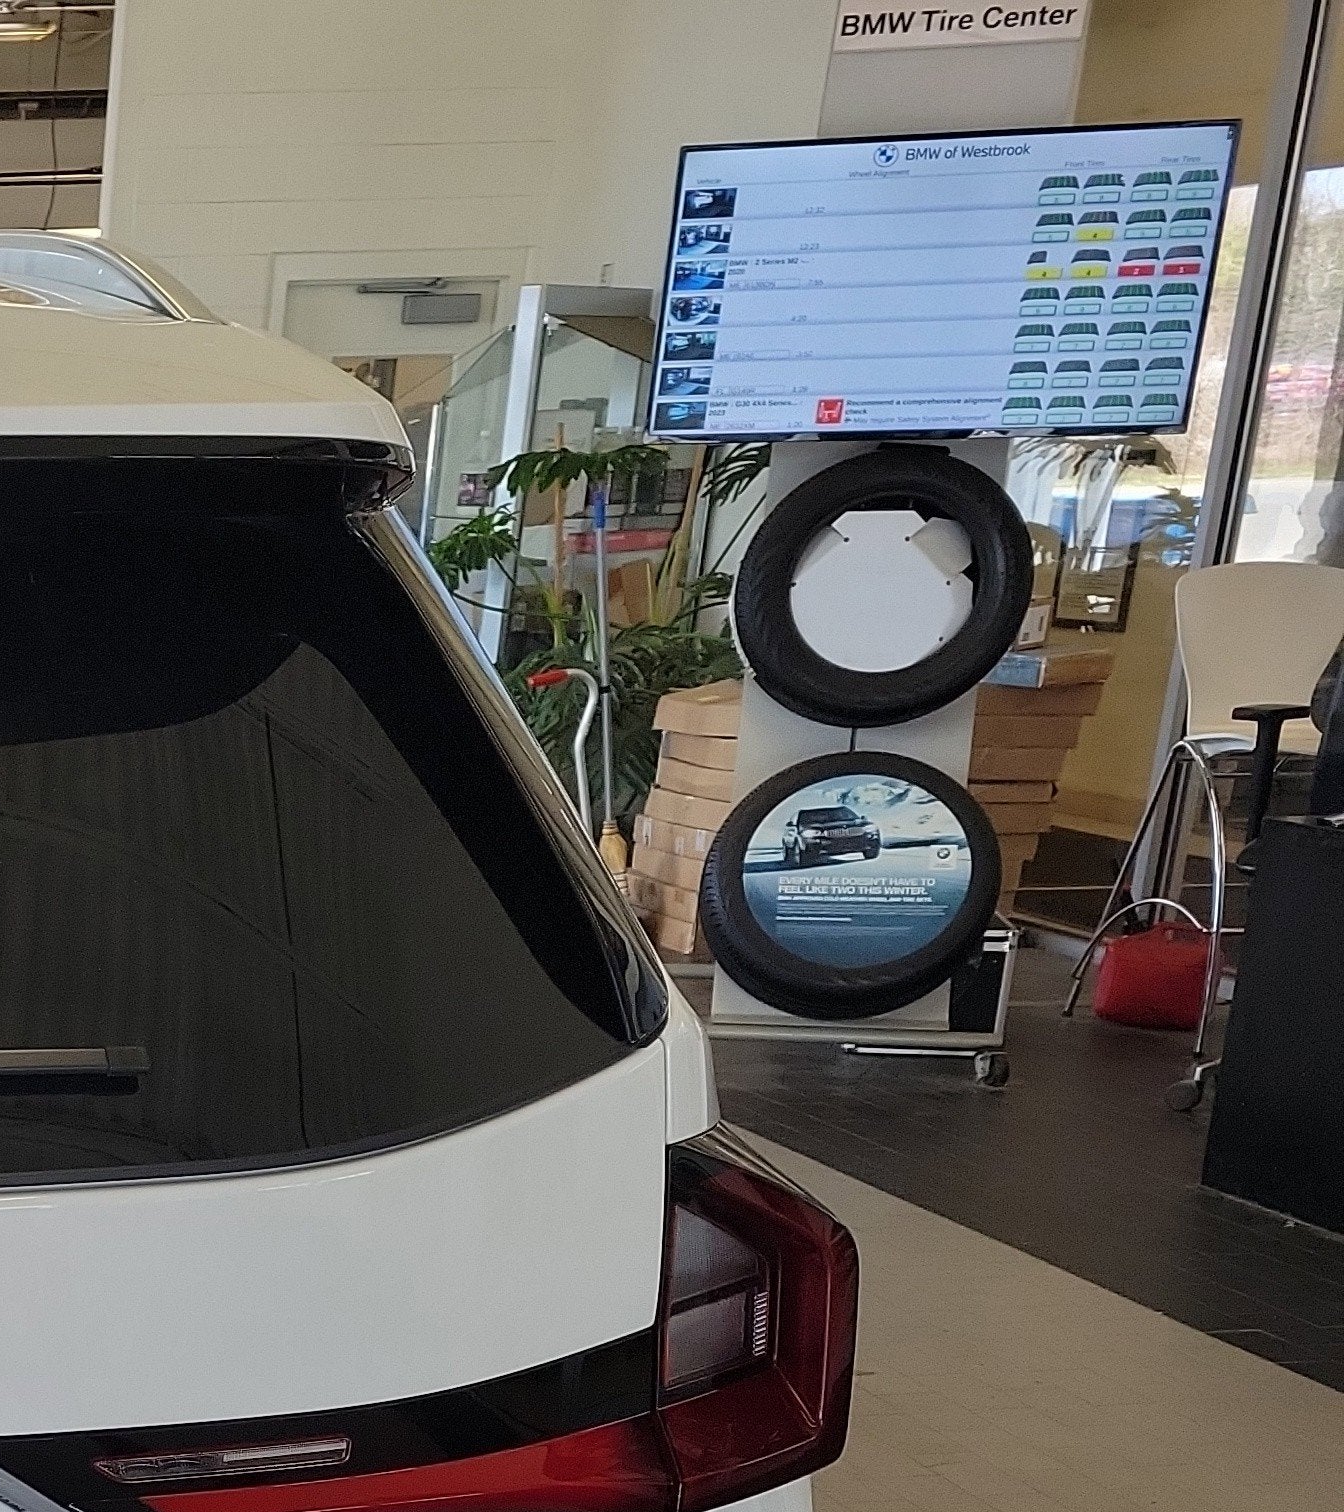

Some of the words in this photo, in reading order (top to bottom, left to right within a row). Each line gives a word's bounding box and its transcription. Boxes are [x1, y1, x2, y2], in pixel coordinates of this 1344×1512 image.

[840, 11, 916, 37] BMW
[921, 9, 974, 32] Tire
[982, 6, 1078, 29] Center
[905, 147, 942, 161] BMW
[944, 145, 958, 159] of
[961, 142, 1031, 158] Westbrook
[779, 876, 811, 885] EVERY
[814, 876, 839, 885] MILE
[842, 877, 886, 886] DOESN'T
[889, 877, 918, 886] HAVE
[920, 877, 936, 887] TO
[778, 885, 805, 894] FEEL
[806, 885, 828, 894] LIKE
[832, 886, 856, 895] TWO
[859, 886, 882, 895] THIS
[884, 886, 928, 895] WINTER.
